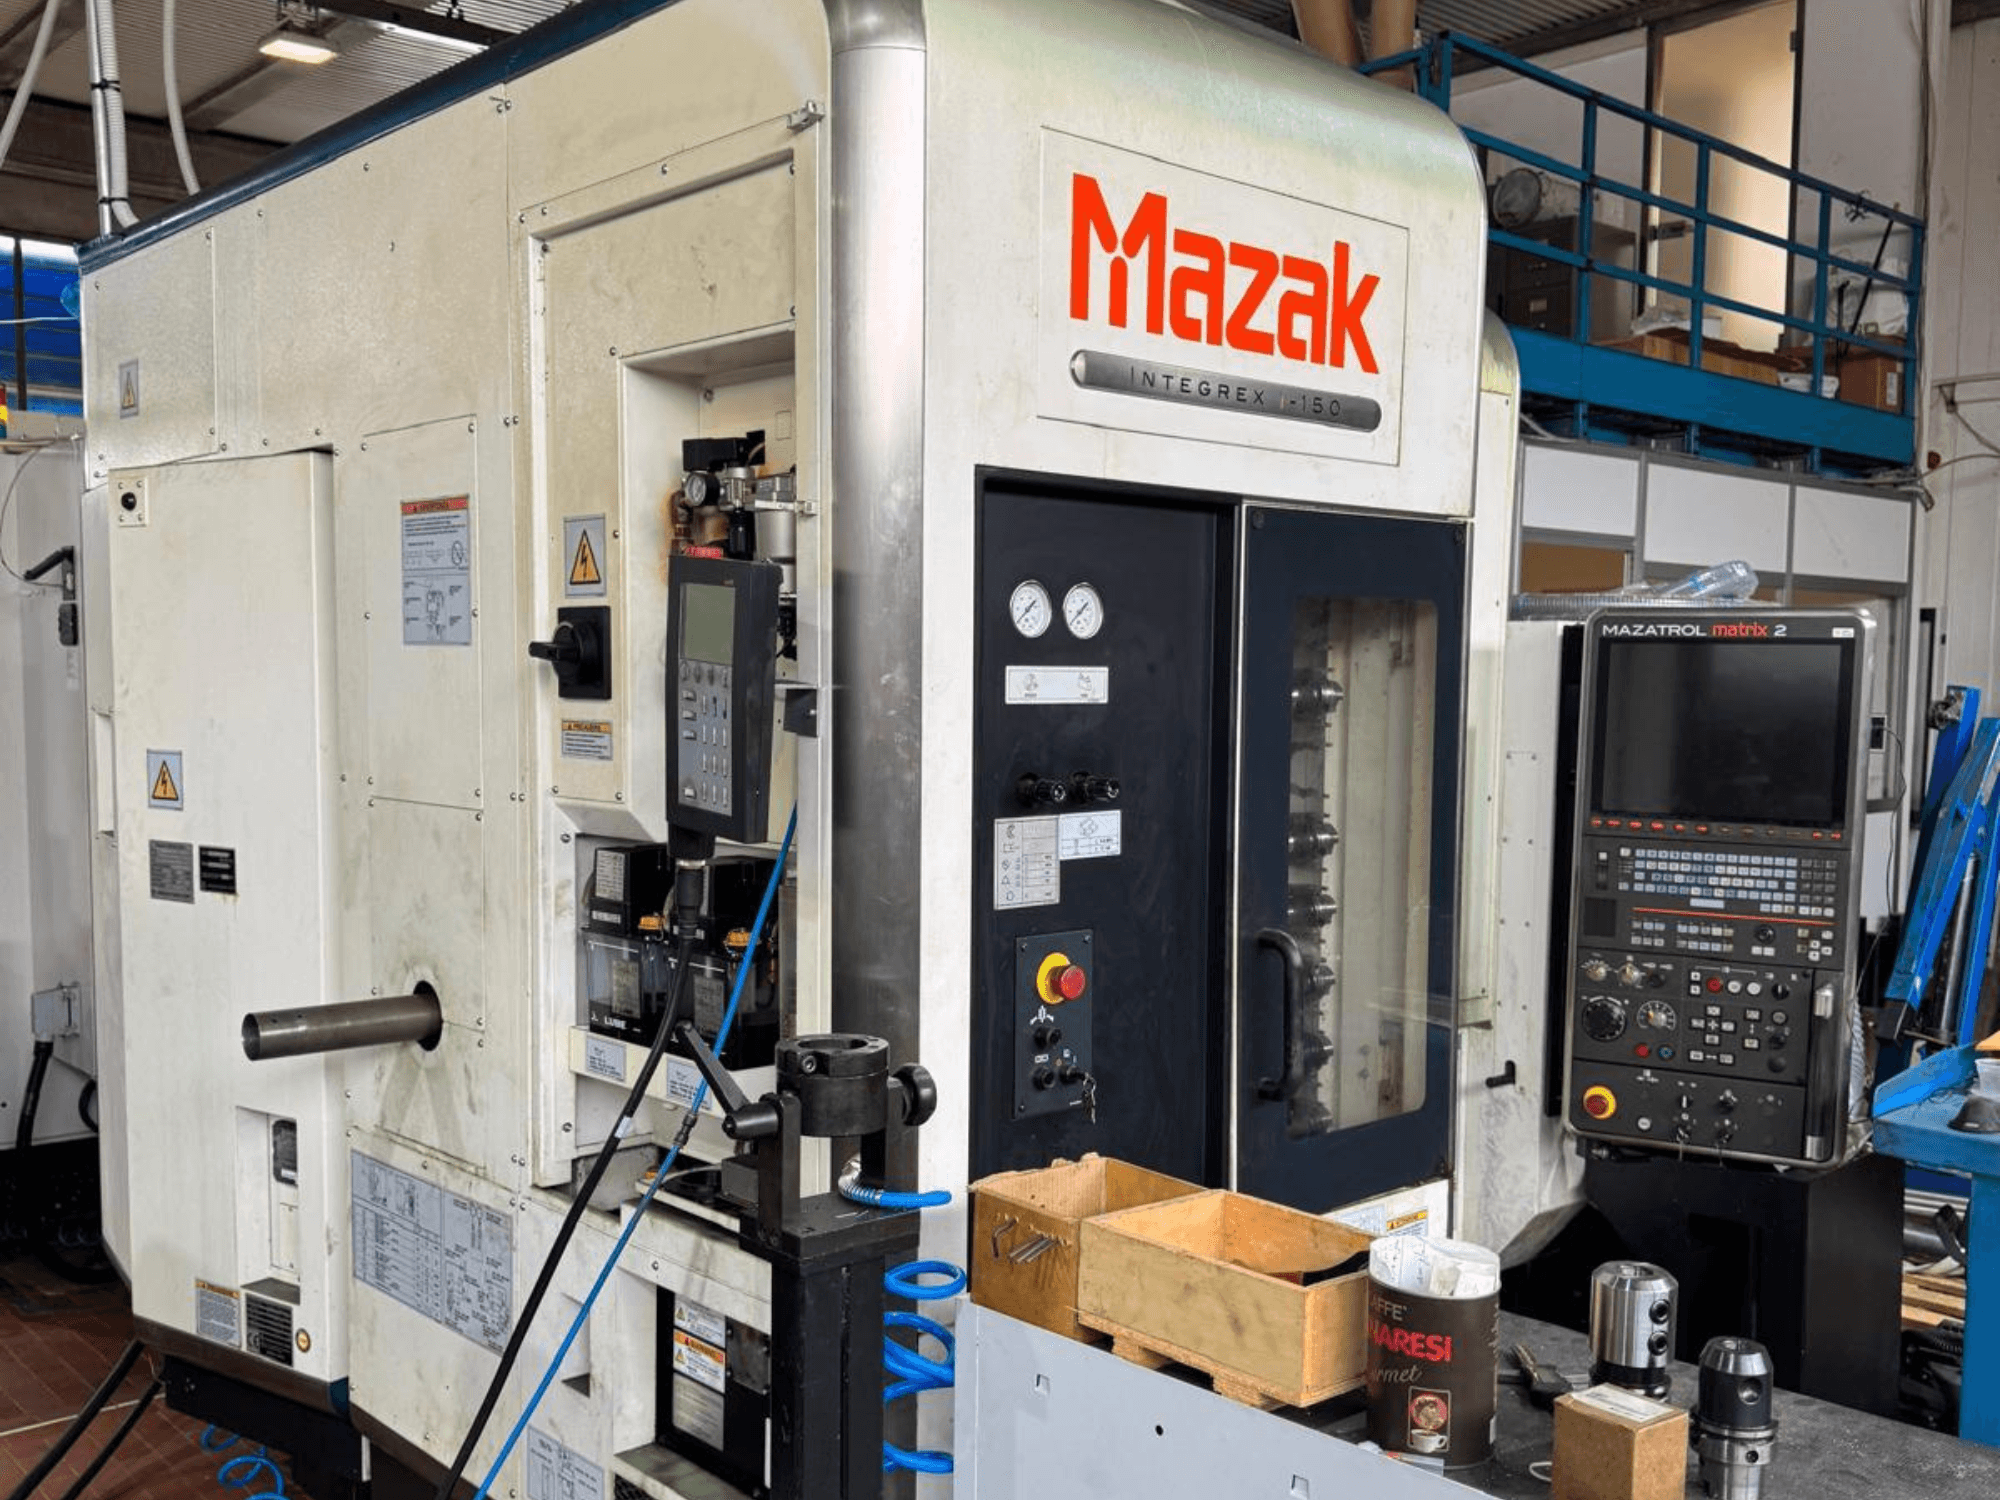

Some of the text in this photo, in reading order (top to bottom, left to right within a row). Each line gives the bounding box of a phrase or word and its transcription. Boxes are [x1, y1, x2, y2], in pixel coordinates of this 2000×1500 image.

[1069, 171, 1381, 375] Mazak
[1130, 365, 1266, 406] INTEGREX
[1602, 622, 1788, 638] MAZATROL matrix 2
